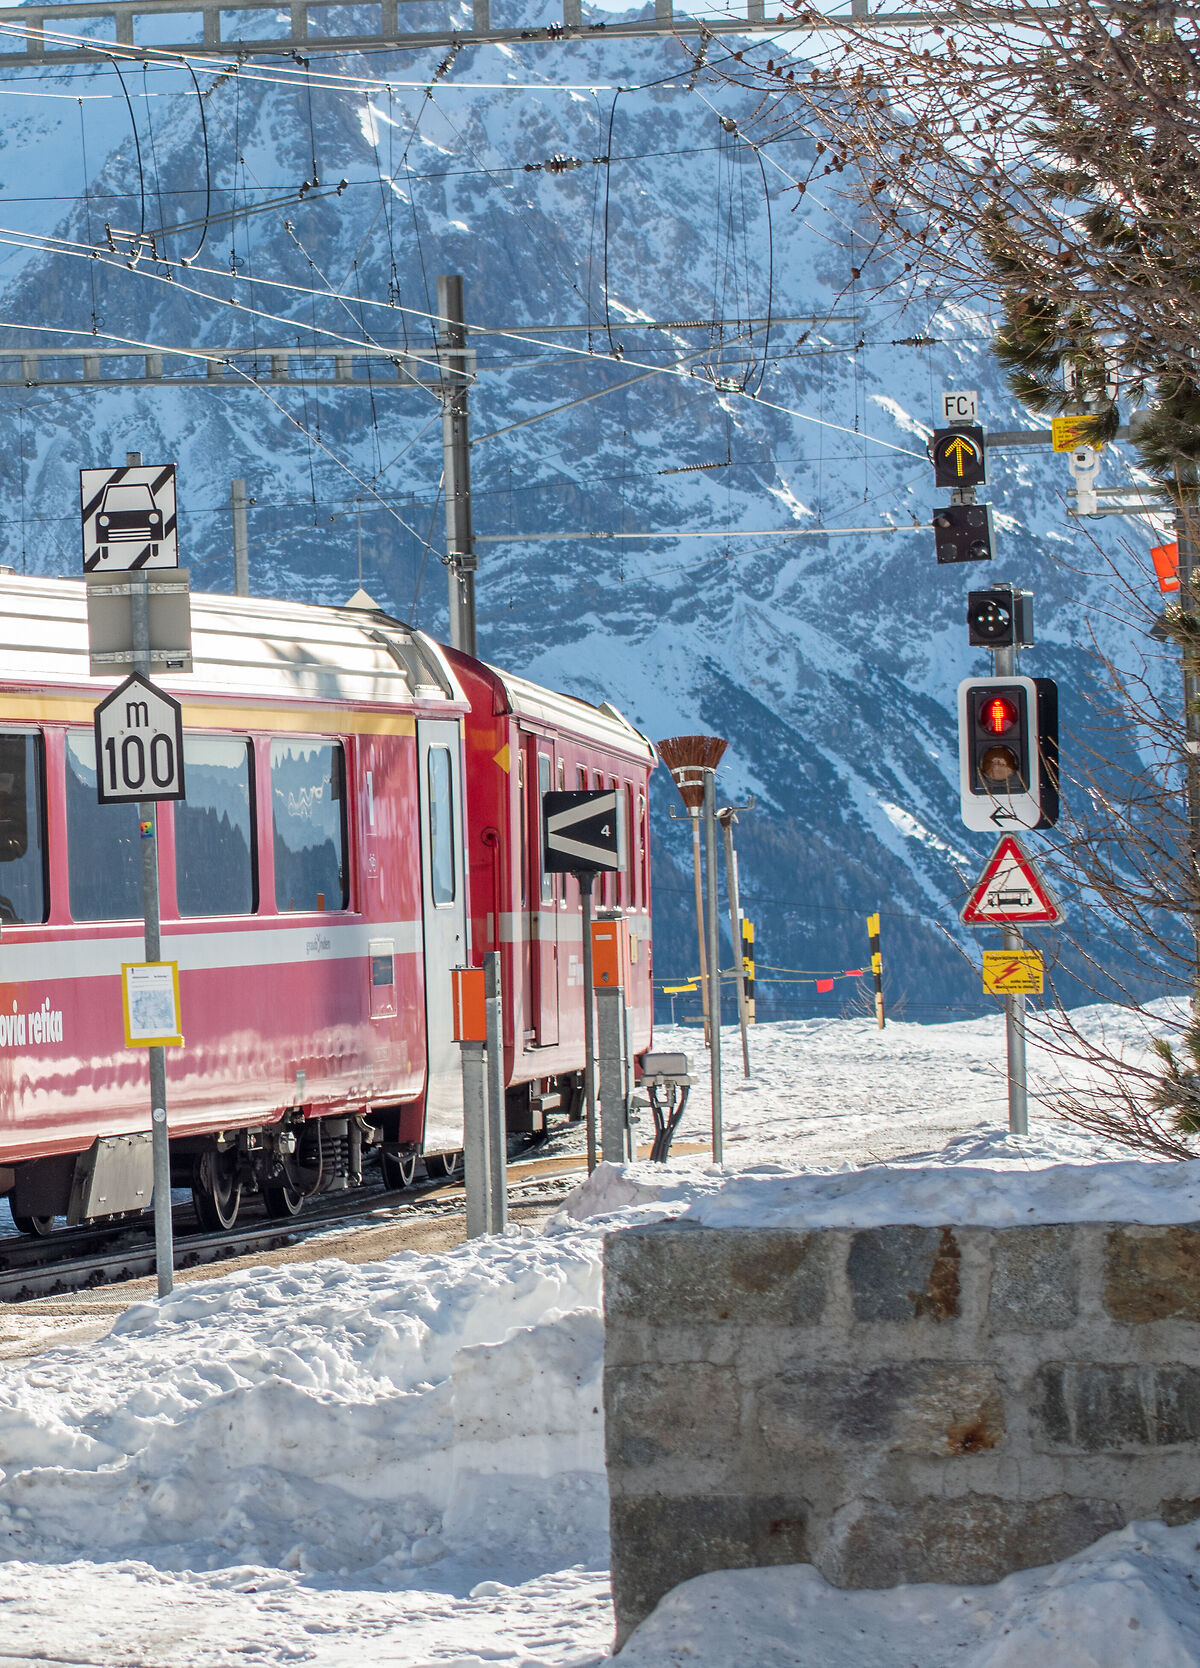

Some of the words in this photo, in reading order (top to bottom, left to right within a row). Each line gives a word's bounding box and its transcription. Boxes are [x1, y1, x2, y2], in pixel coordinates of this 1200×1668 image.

[944, 396, 975, 416] FC1
[125, 701, 149, 728] m
[105, 733, 175, 790] 100
[600, 824, 612, 837] 4
[28, 996, 64, 1045] retica
